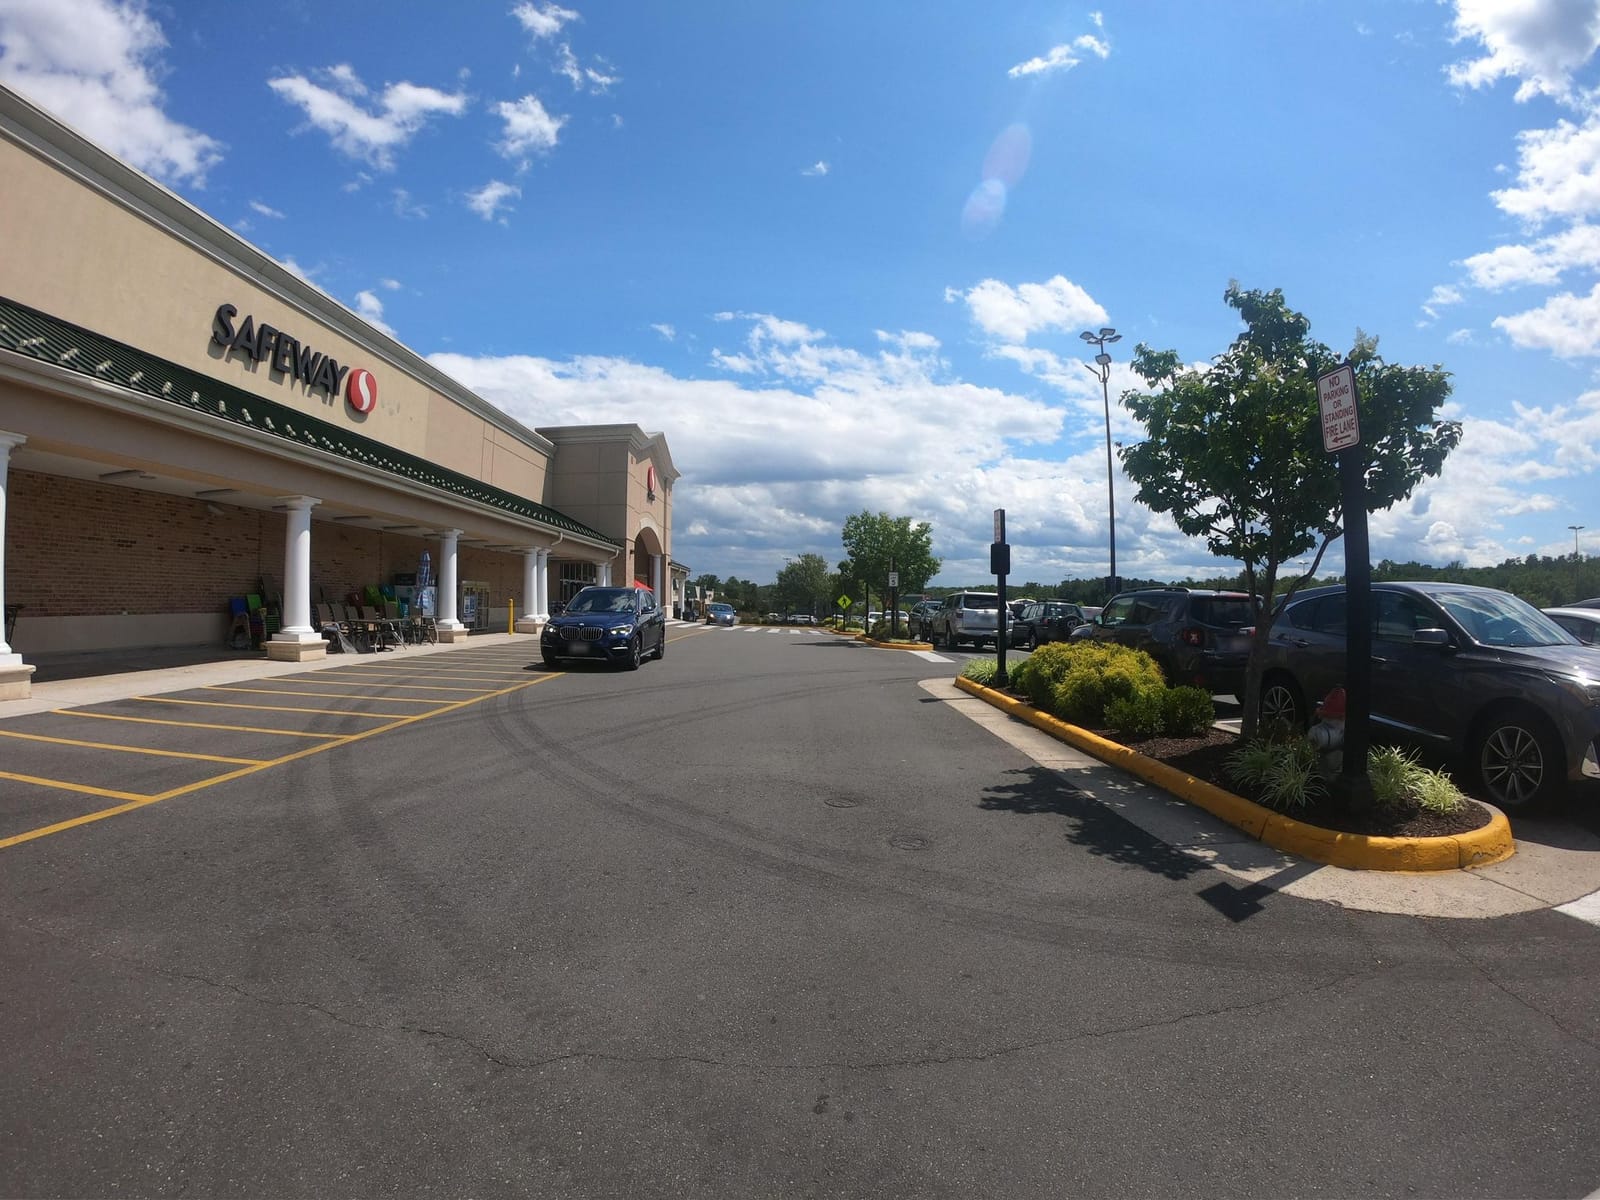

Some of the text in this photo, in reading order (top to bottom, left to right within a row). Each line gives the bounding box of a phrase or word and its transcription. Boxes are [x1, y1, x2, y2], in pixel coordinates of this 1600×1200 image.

[211, 303, 349, 396] SAFEWAY
[1329, 376, 1340, 388] NO
[1323, 385, 1349, 401] PARKING
[1333, 400, 1342, 408] OR
[1325, 406, 1353, 423] STANDING
[1326, 418, 1355, 438] FIRE LANE
